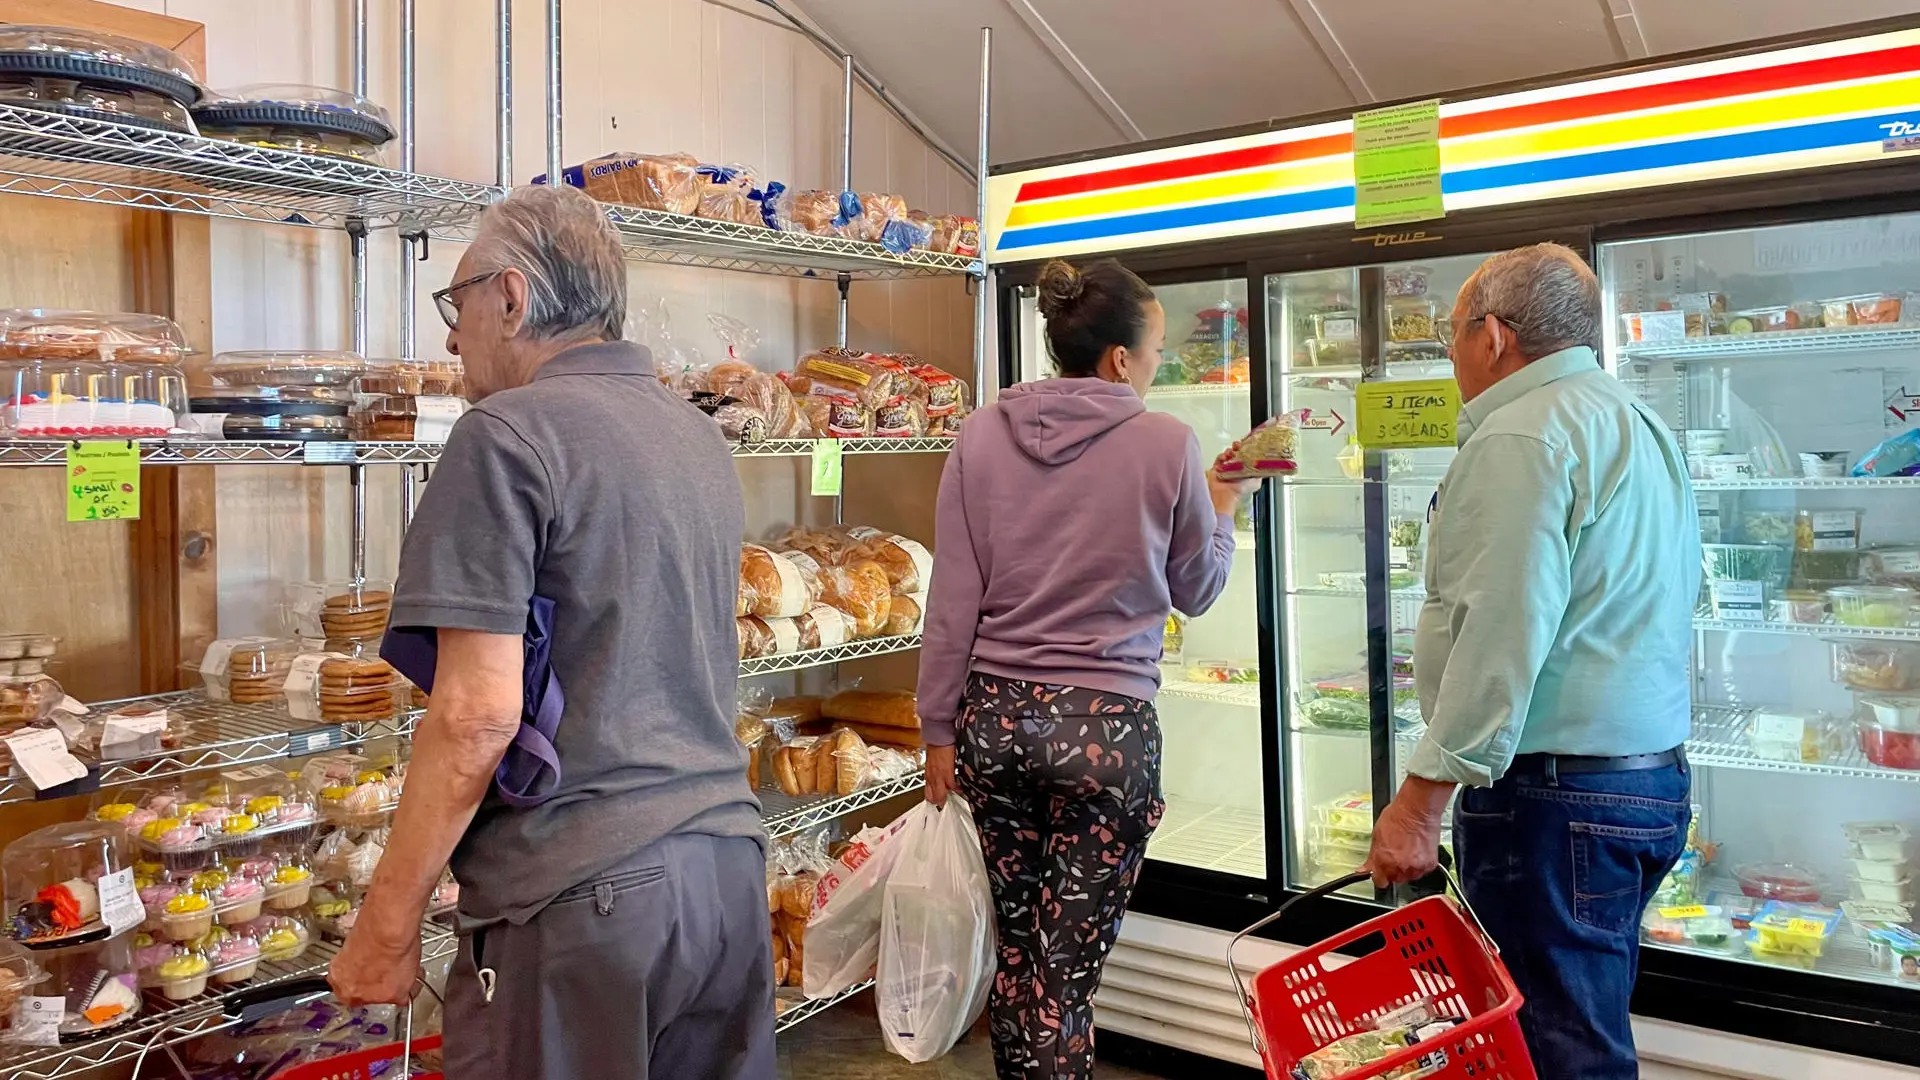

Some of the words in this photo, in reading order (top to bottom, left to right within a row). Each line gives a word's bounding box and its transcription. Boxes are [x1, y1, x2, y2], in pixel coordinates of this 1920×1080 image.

[1382, 395, 1393, 409] 3
[1401, 395, 1446, 409] ITEMS
[1311, 418, 1327, 427] Open
[1377, 424, 1387, 439] 3
[1390, 421, 1449, 439] SALADS
